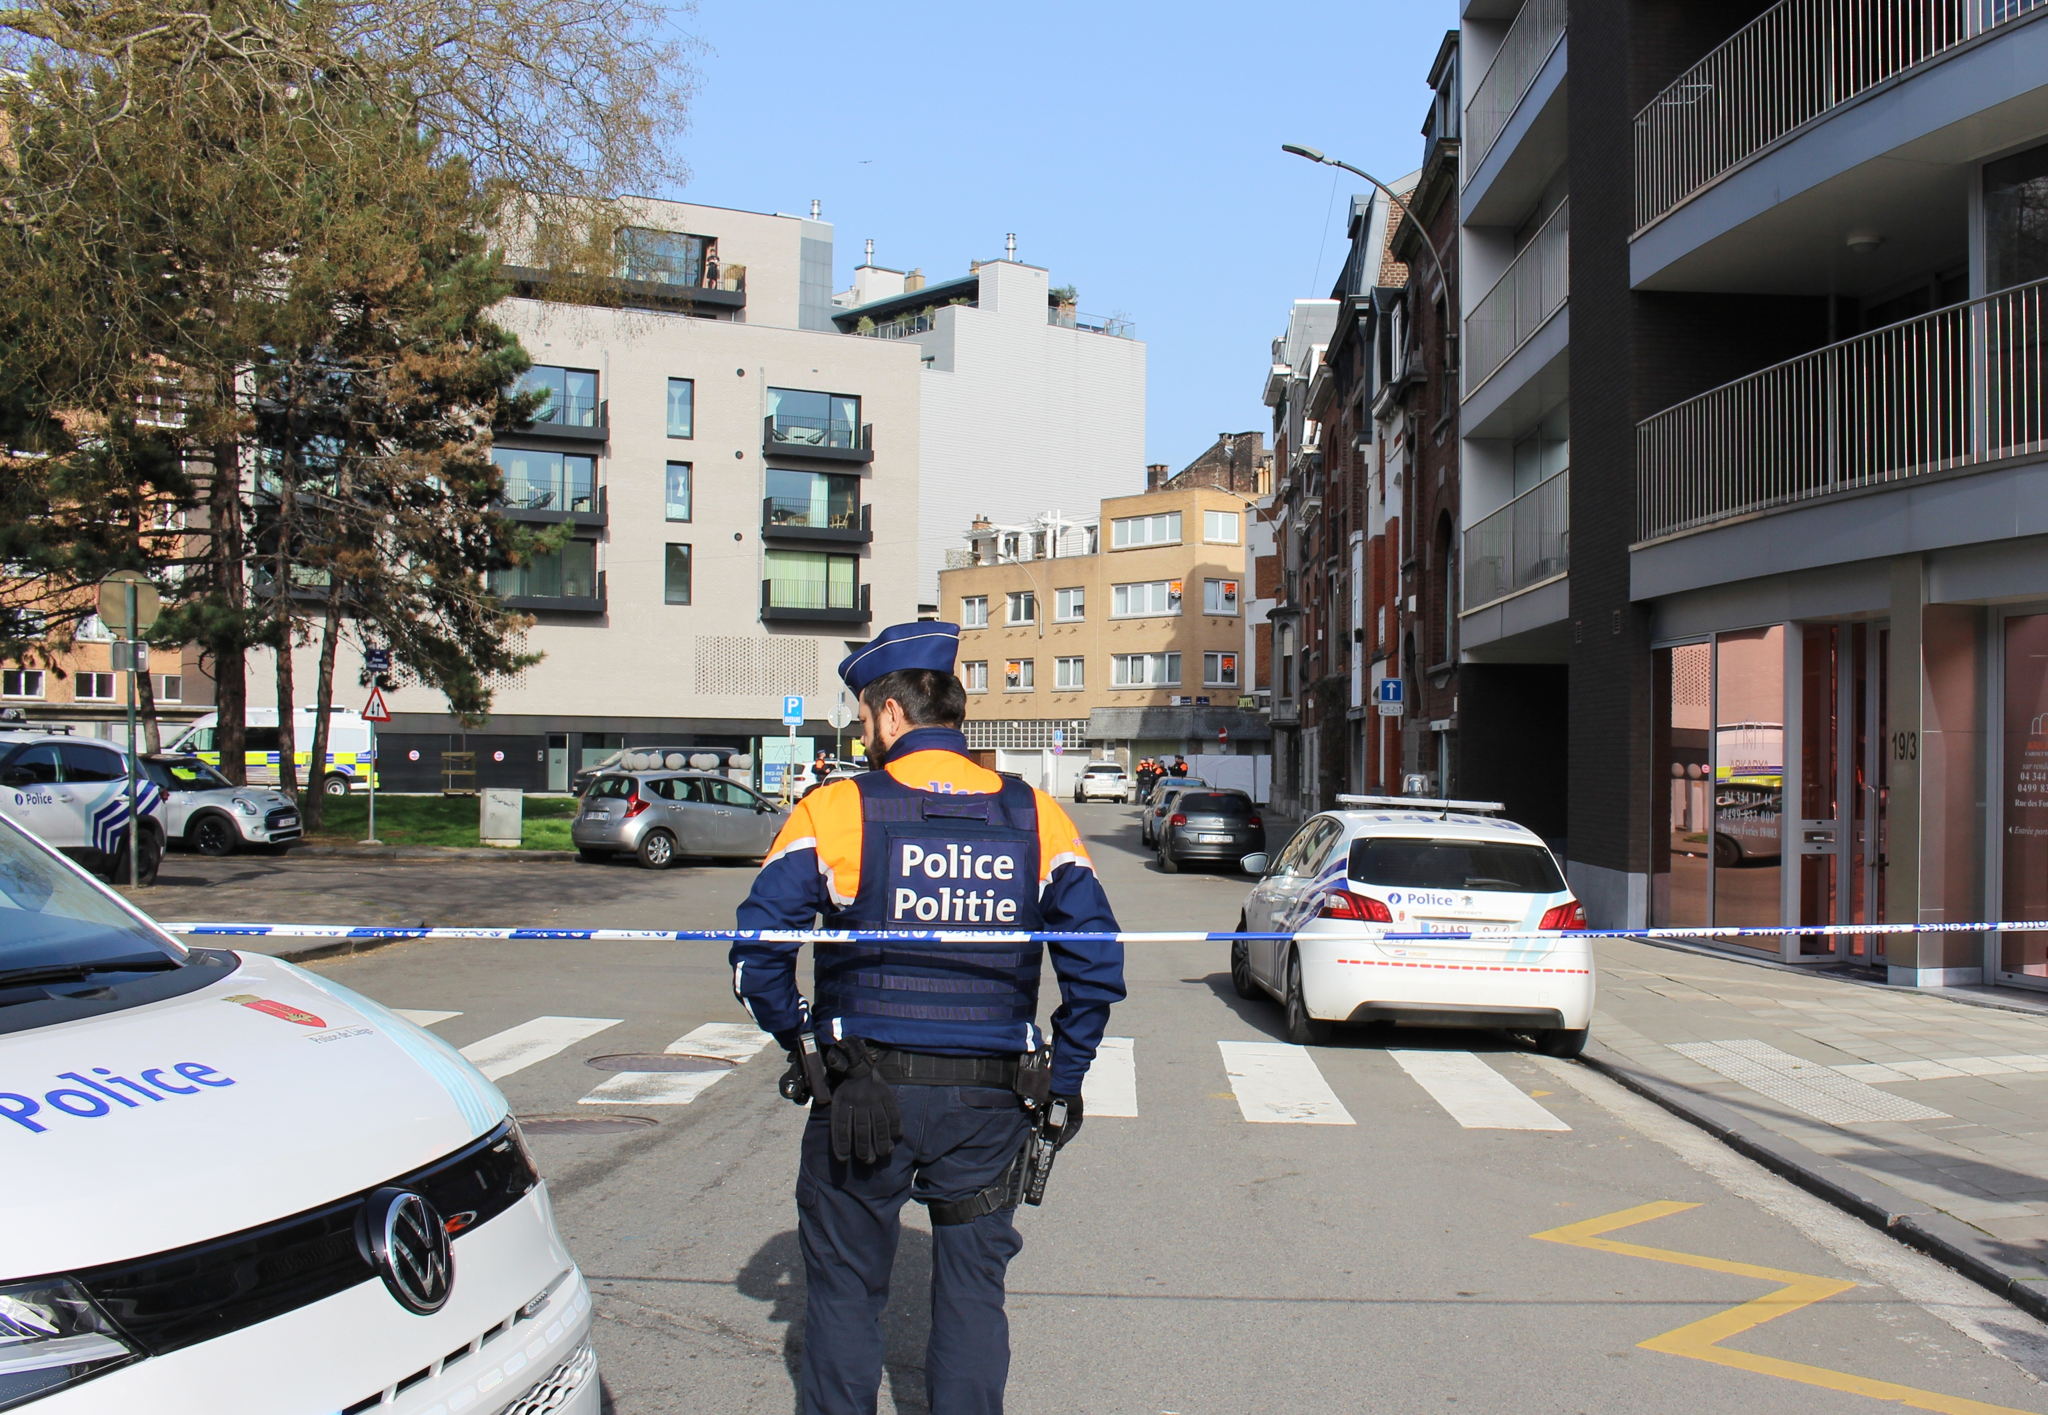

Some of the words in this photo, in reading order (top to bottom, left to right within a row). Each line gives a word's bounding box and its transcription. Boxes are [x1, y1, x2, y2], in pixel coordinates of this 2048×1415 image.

[1892, 731, 1917, 760] 19/3
[2020, 772, 2030, 781] 04
[2032, 772, 2046, 781] 344
[2017, 784, 2037, 793] 0499
[26, 792, 52, 805] Police
[1752, 792, 1761, 805] 17
[1761, 811, 1775, 823] 000
[901, 844, 1015, 880] Police
[893, 887, 1017, 922] Politie
[1407, 893, 1453, 906] Police
[0, 1062, 236, 1133] Police
